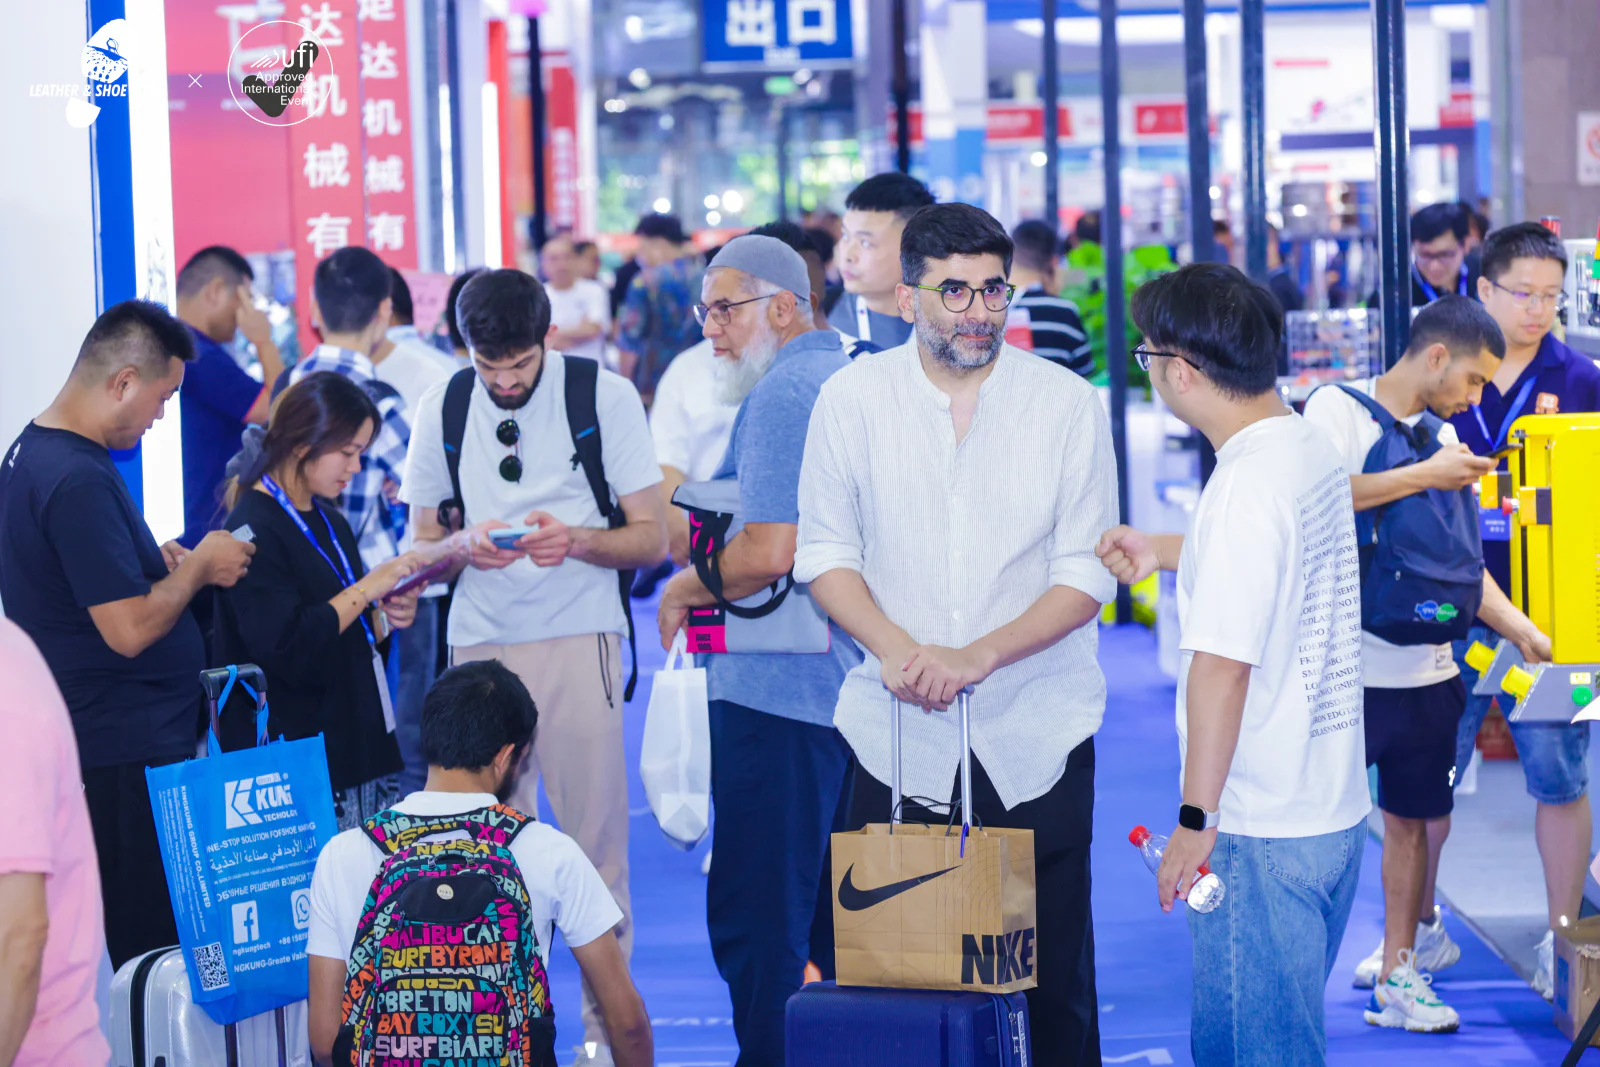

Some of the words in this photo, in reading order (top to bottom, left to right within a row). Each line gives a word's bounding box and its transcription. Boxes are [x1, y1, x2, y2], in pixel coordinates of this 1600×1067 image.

[181, 785, 194, 830] KINGKUNG
[188, 830, 200, 859] GROUP
[961, 926, 1035, 985] NIKE
